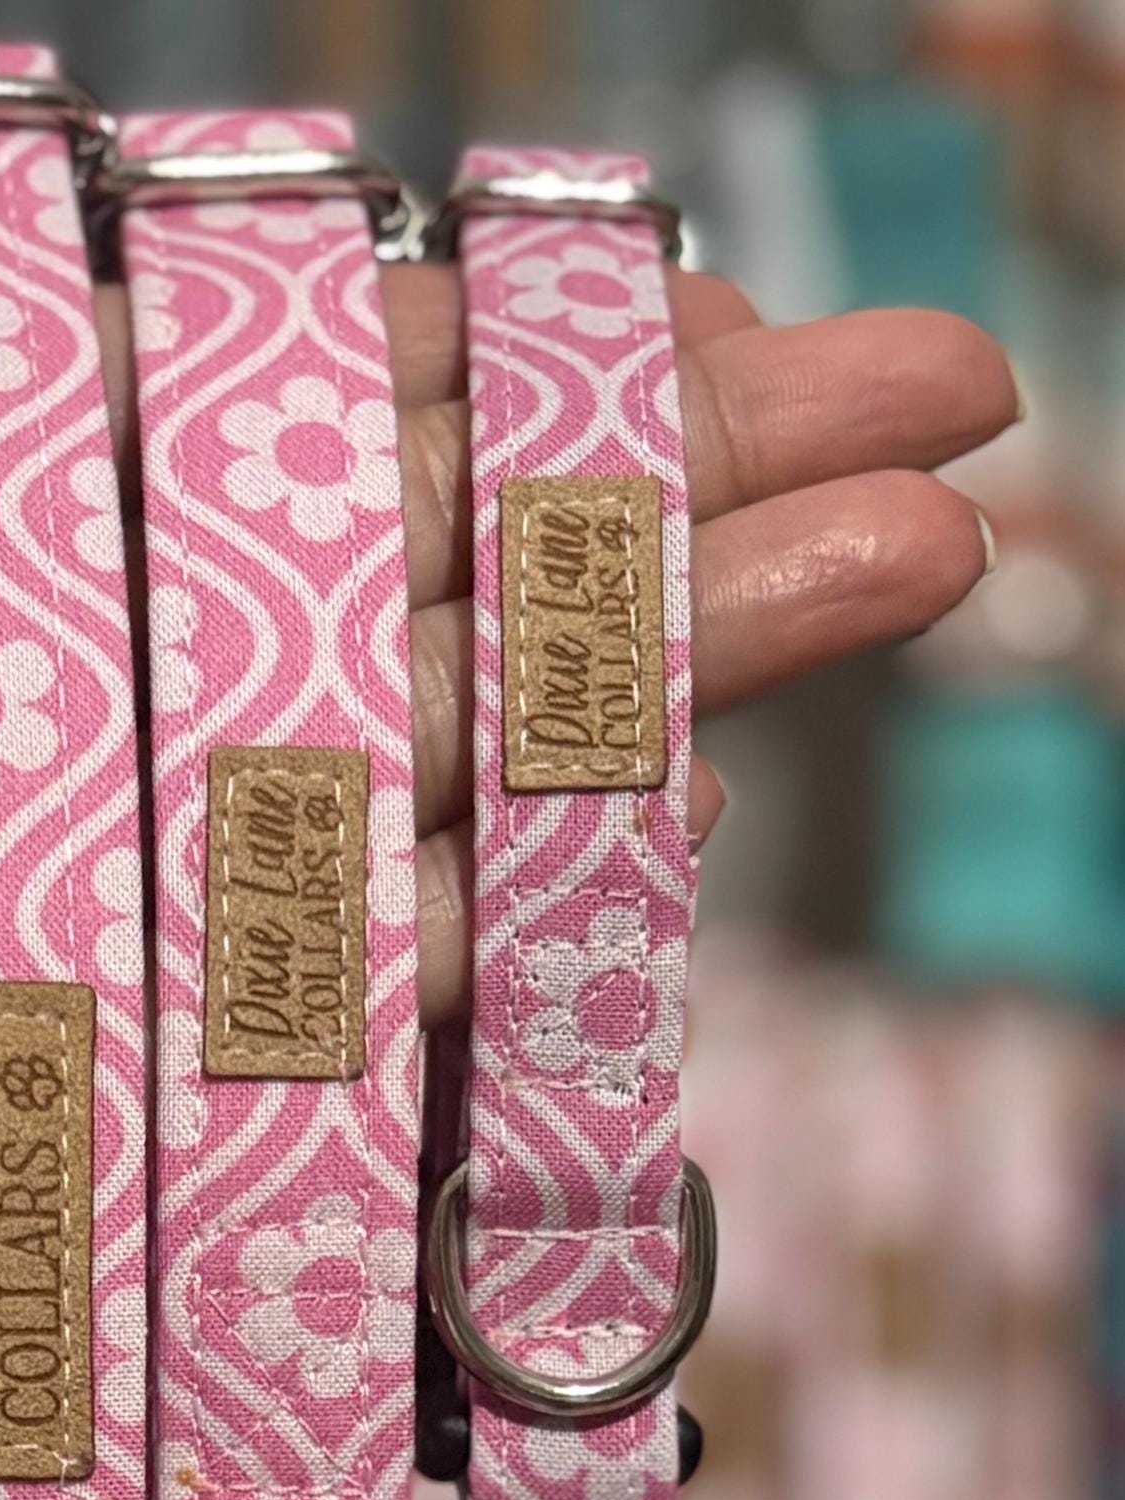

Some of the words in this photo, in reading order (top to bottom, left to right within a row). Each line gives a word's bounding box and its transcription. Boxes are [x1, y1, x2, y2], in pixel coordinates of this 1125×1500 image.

[527, 506, 594, 614] Lane
[526, 632, 599, 748] Dixie
[598, 569, 640, 749] COLLARS
[231, 781, 298, 896] Lane
[229, 918, 299, 1040] Dixie
[301, 850, 346, 1043] COLLARS
[0, 1140, 62, 1427] COLLARS
